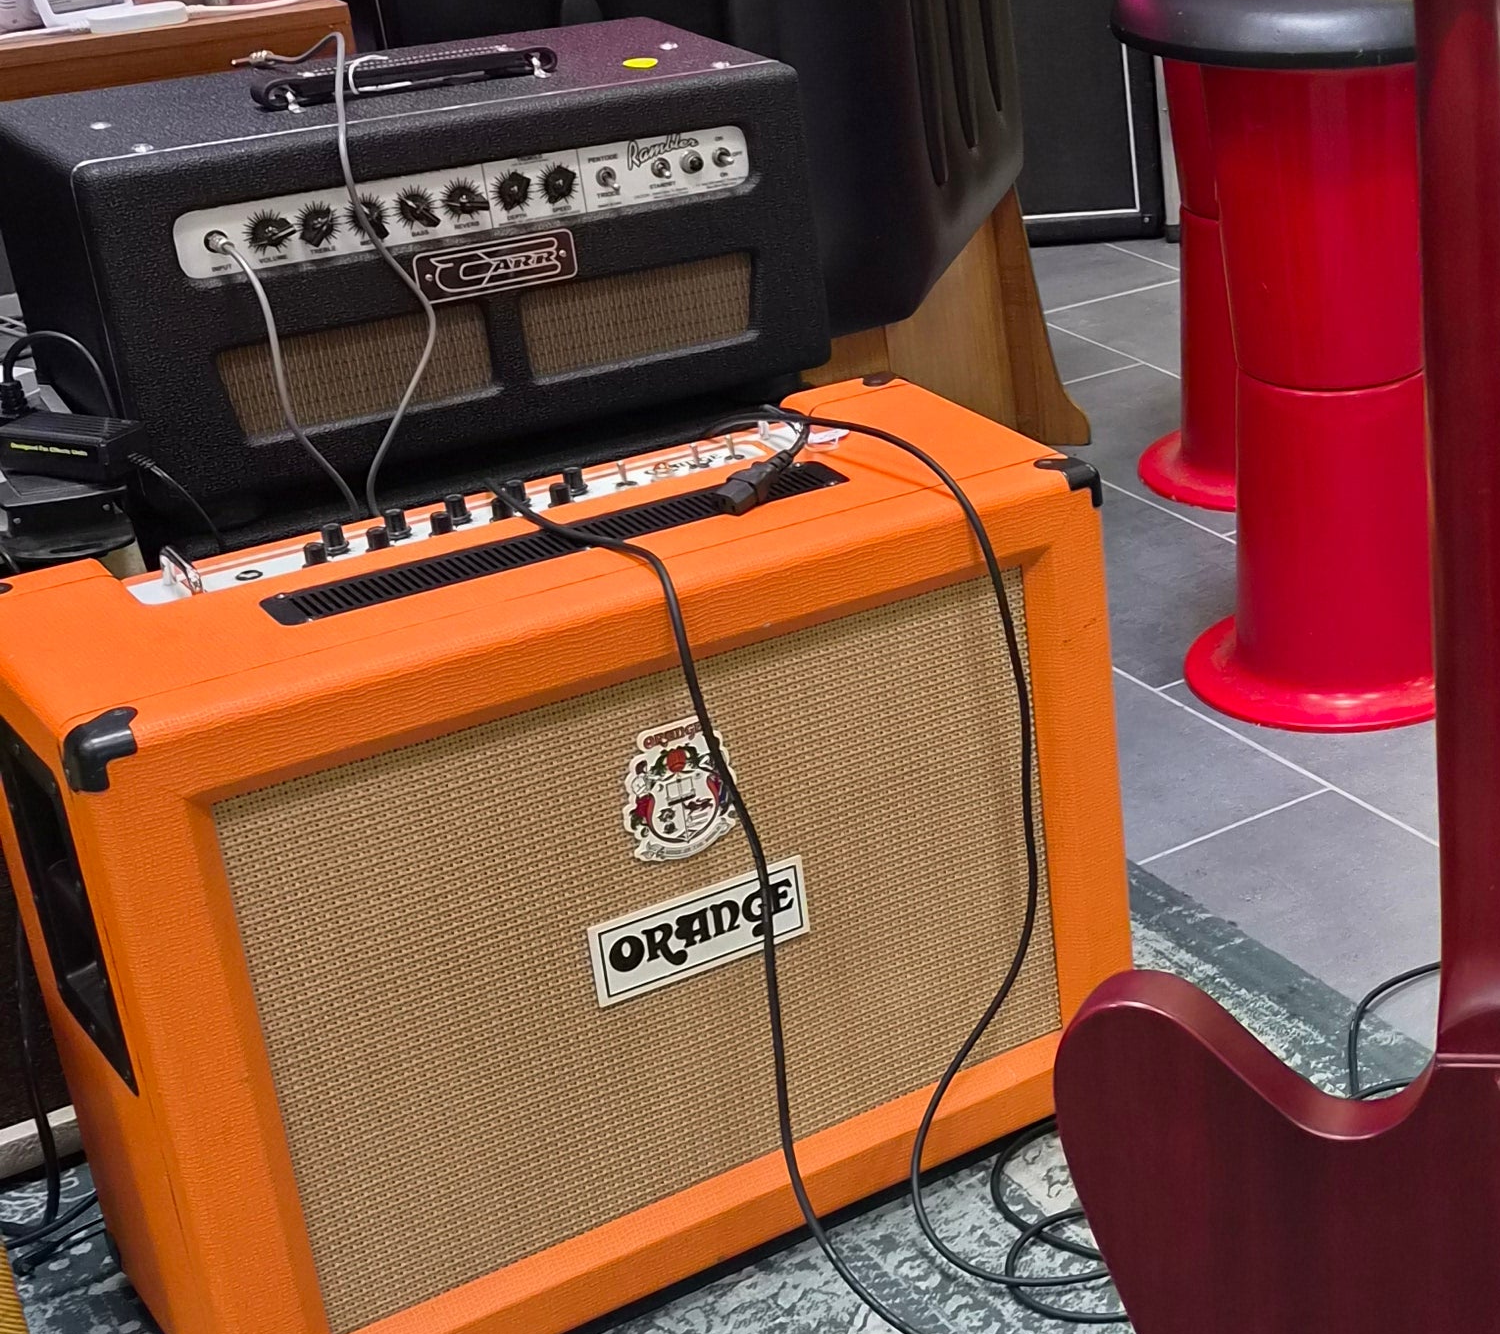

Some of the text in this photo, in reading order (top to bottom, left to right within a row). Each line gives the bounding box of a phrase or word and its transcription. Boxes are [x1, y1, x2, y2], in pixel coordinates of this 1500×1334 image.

[627, 133, 699, 171] Rambler
[430, 237, 562, 293] CARR
[608, 878, 795, 972] ORANGE
